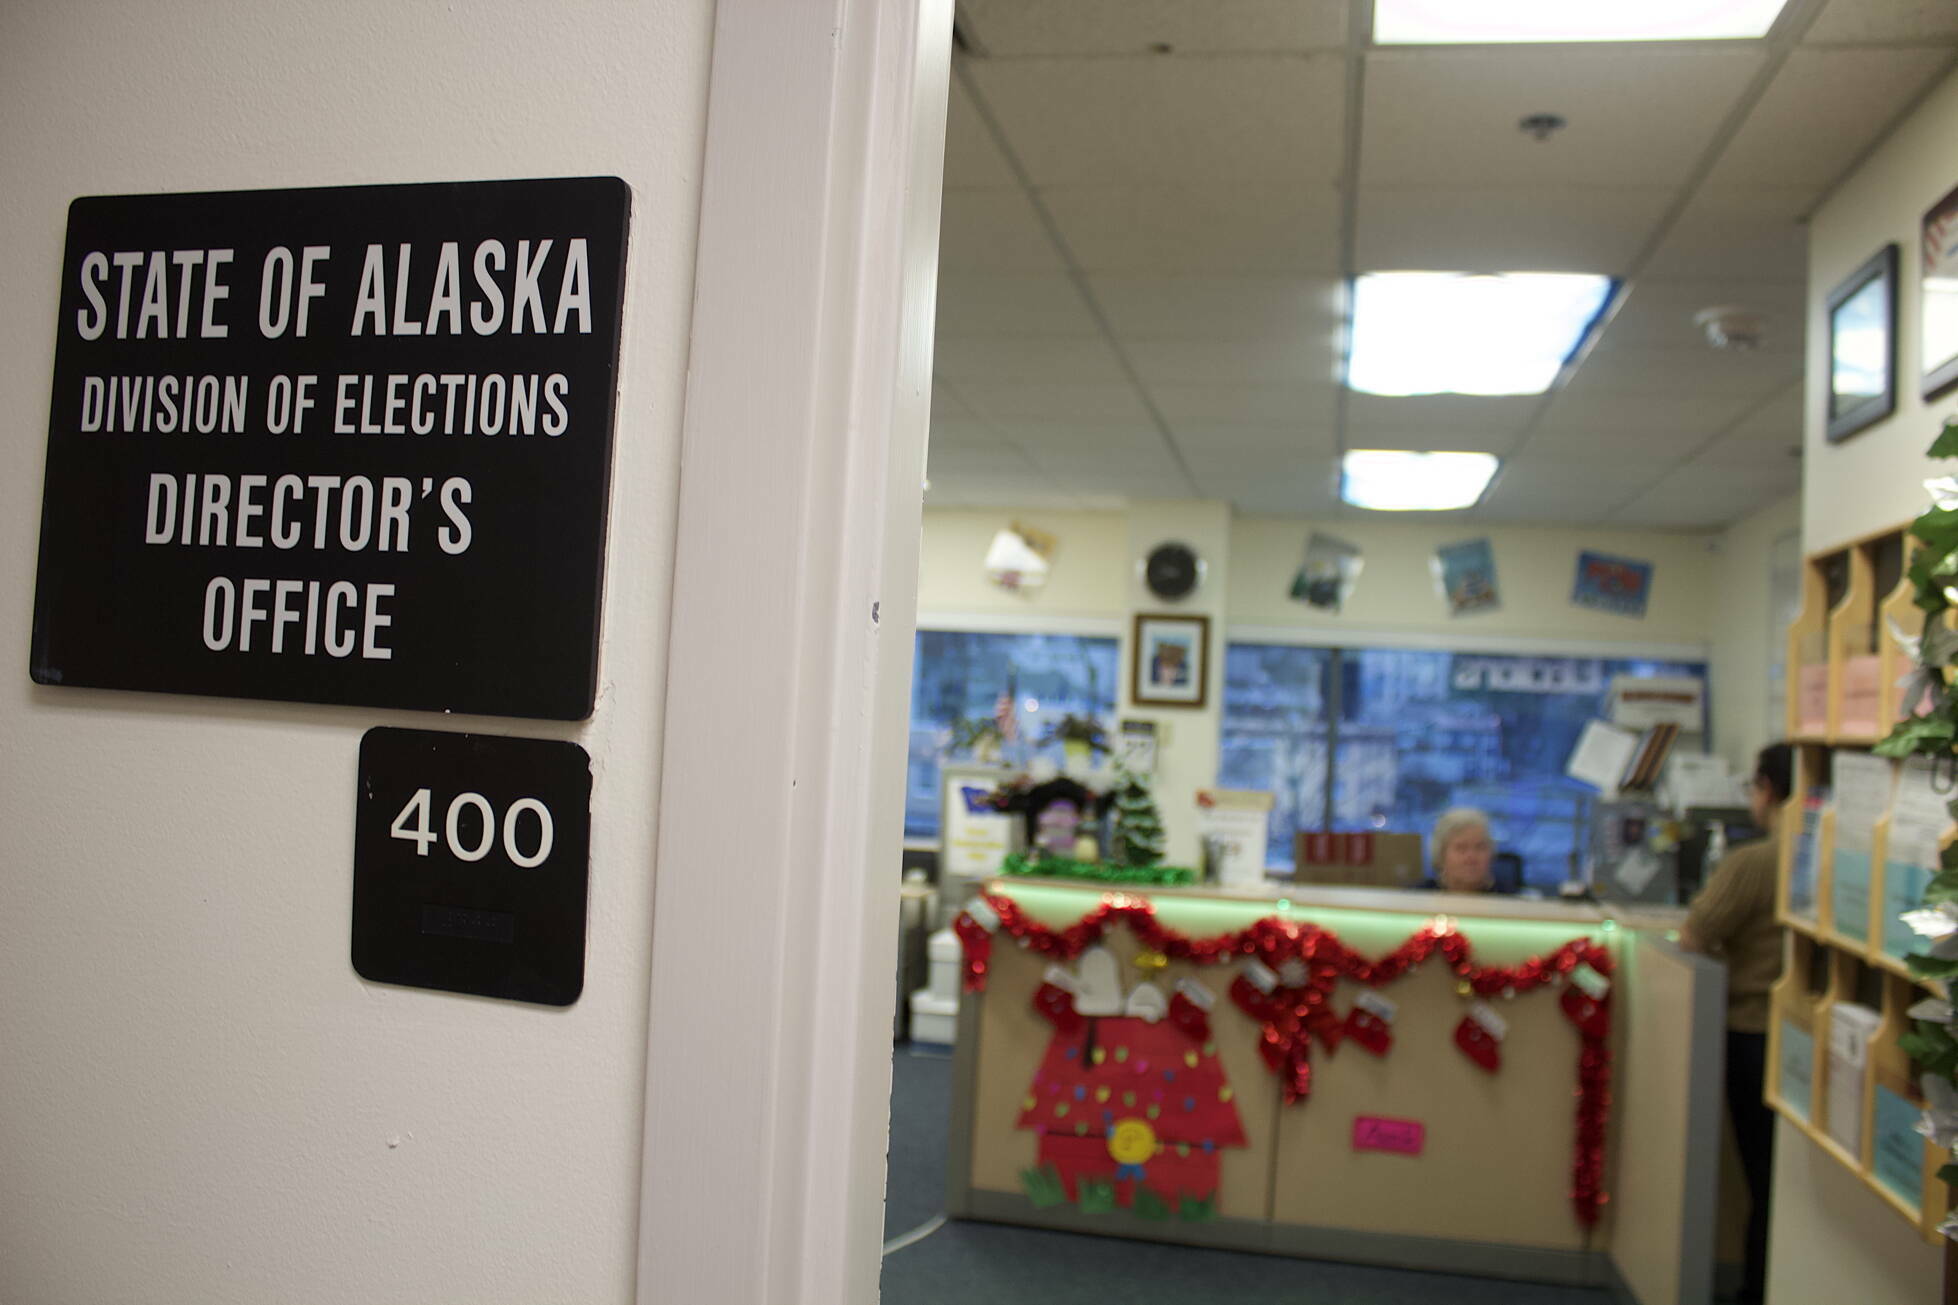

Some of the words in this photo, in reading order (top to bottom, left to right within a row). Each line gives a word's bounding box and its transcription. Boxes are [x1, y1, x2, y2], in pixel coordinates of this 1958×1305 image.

[77, 248, 234, 341] STATE
[258, 246, 331, 340] OF
[350, 239, 592, 337] ALASKA
[81, 375, 249, 434] DIVISION
[266, 374, 318, 434] OF
[334, 373, 570, 437] ELECTIONS
[145, 473, 473, 555] DIRECTOR'S
[202, 576, 396, 660] OFFICE
[390, 788, 554, 869] 400
